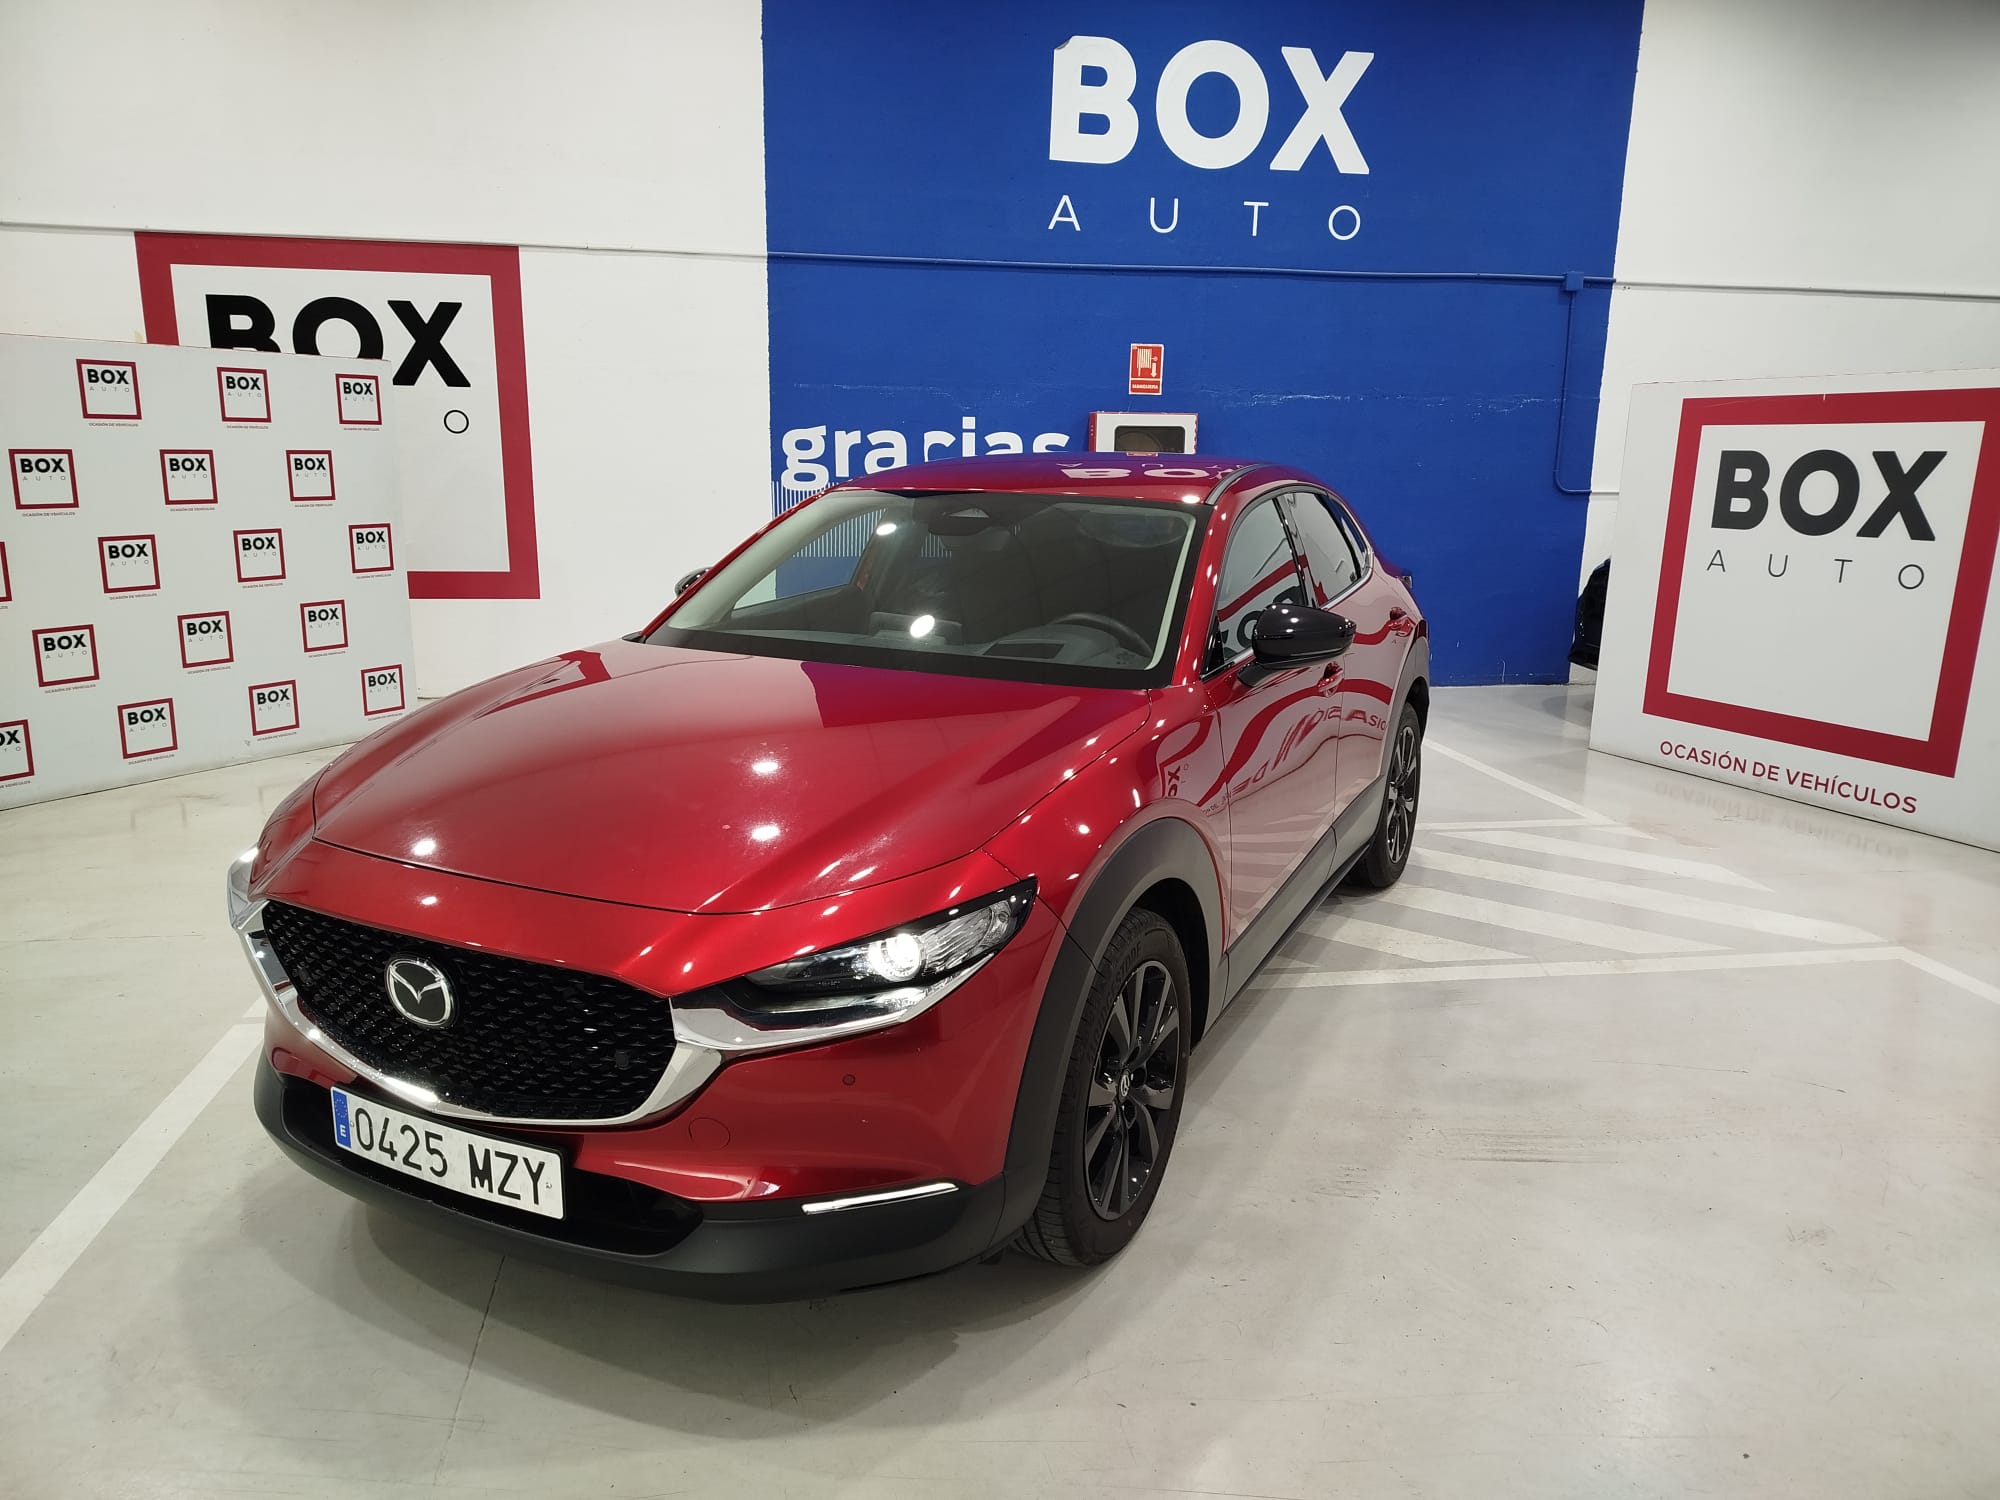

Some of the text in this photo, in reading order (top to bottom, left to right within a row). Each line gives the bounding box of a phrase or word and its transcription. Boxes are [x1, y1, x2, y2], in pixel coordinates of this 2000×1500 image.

[1049, 35, 1374, 174] BOX
[1048, 194, 1361, 241] AUTO
[205, 294, 471, 387] BOX
[87, 368, 129, 384] BOX
[226, 376, 261, 390] BOX
[343, 382, 373, 395] BOX
[20, 458, 65, 473] BOX
[170, 458, 207, 472] BOX
[294, 458, 326, 470] BOX
[1711, 449, 1948, 541] BOX
[242, 536, 276, 550] BOX
[356, 530, 386, 544] BOX
[108, 543, 148, 559] BOX
[1706, 549, 1925, 590] AUTO
[308, 608, 340, 622] BOX
[186, 620, 224, 636] BOX
[43, 634, 86, 652] BOX
[46, 650, 88, 659] AUTO
[368, 672, 397, 688] BOX
[257, 688, 290, 705] BOX
[127, 706, 166, 726] BOX
[129, 722, 167, 732] AUTO
[1659, 740, 1918, 814] OCASIÓN DE VEHÍCULOS
[339, 1125, 347, 1138] E
[354, 1107, 546, 1205] 0425 MZY
